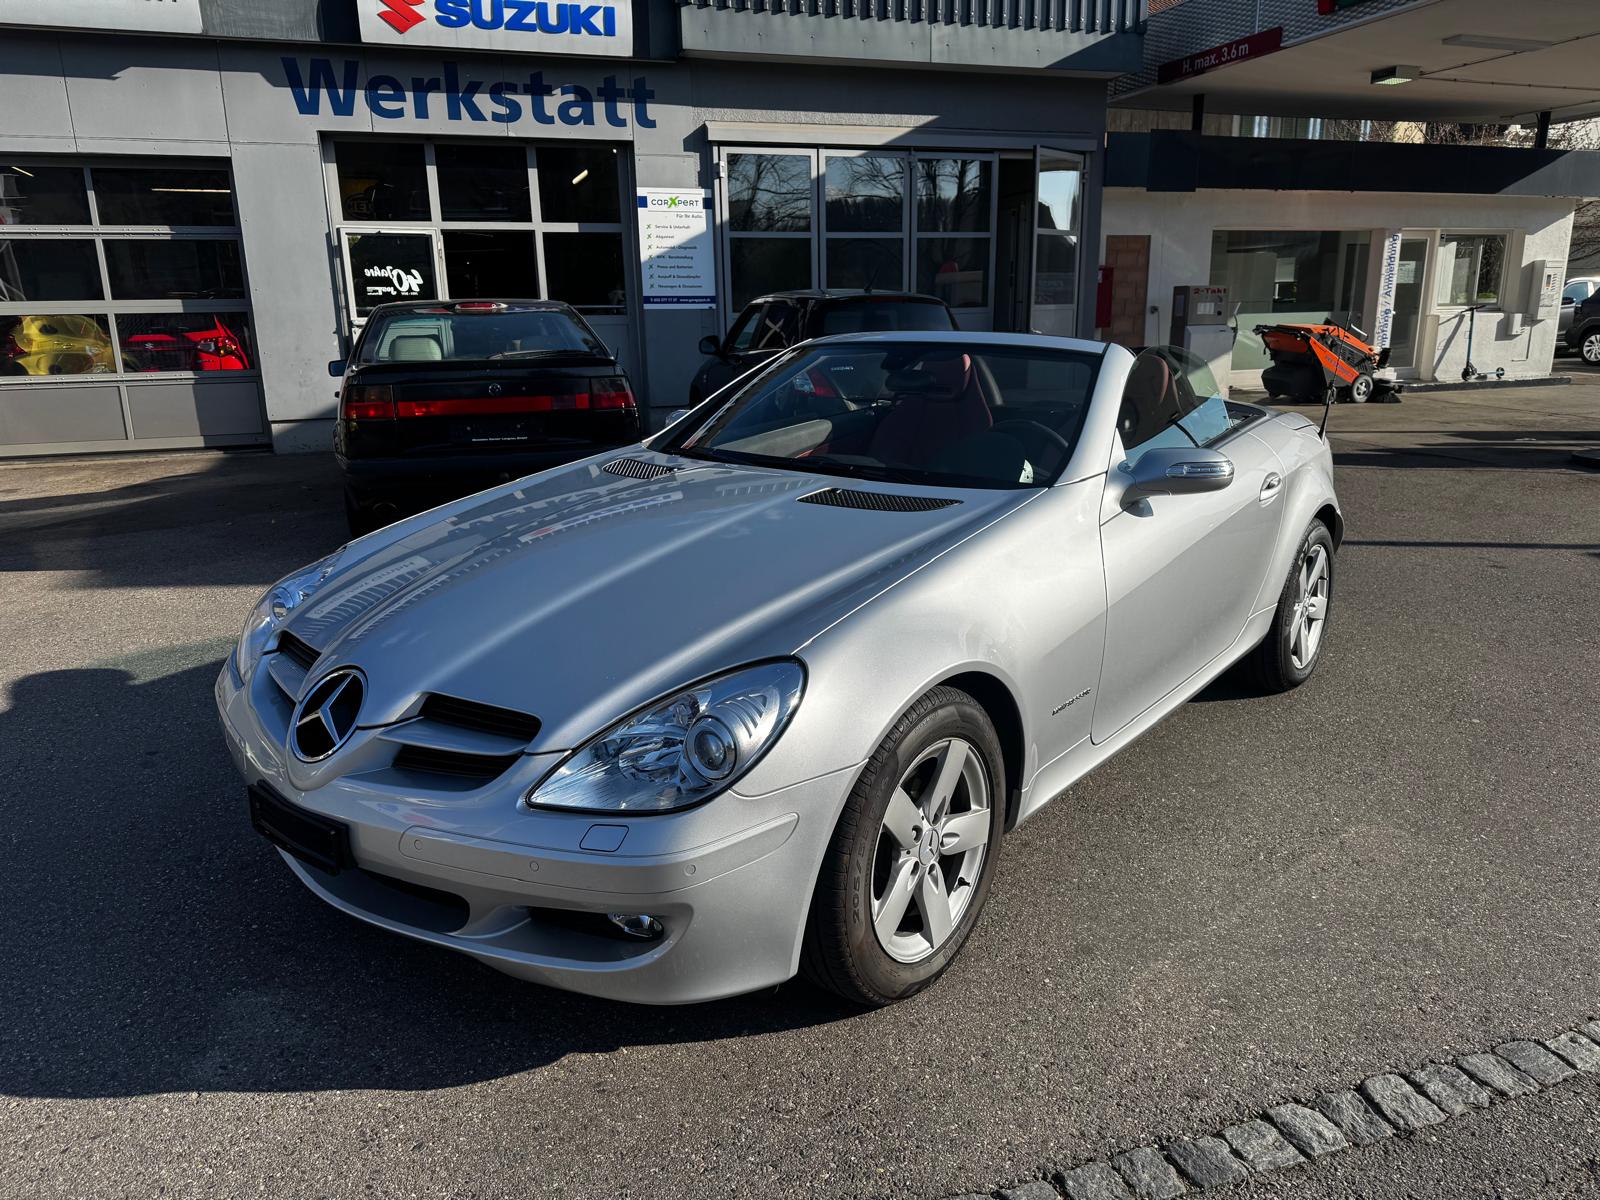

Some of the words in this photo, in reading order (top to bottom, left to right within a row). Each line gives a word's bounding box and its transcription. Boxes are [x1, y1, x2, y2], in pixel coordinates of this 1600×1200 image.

[435, 0, 616, 37] SUZUKI
[1182, 60, 1193, 73] H.
[1194, 53, 1219, 71] max.
[1221, 43, 1237, 62] 3.6
[1238, 43, 1249, 57] m
[280, 57, 657, 129] Werkstatt
[1384, 234, 1400, 297] Anmeldung
